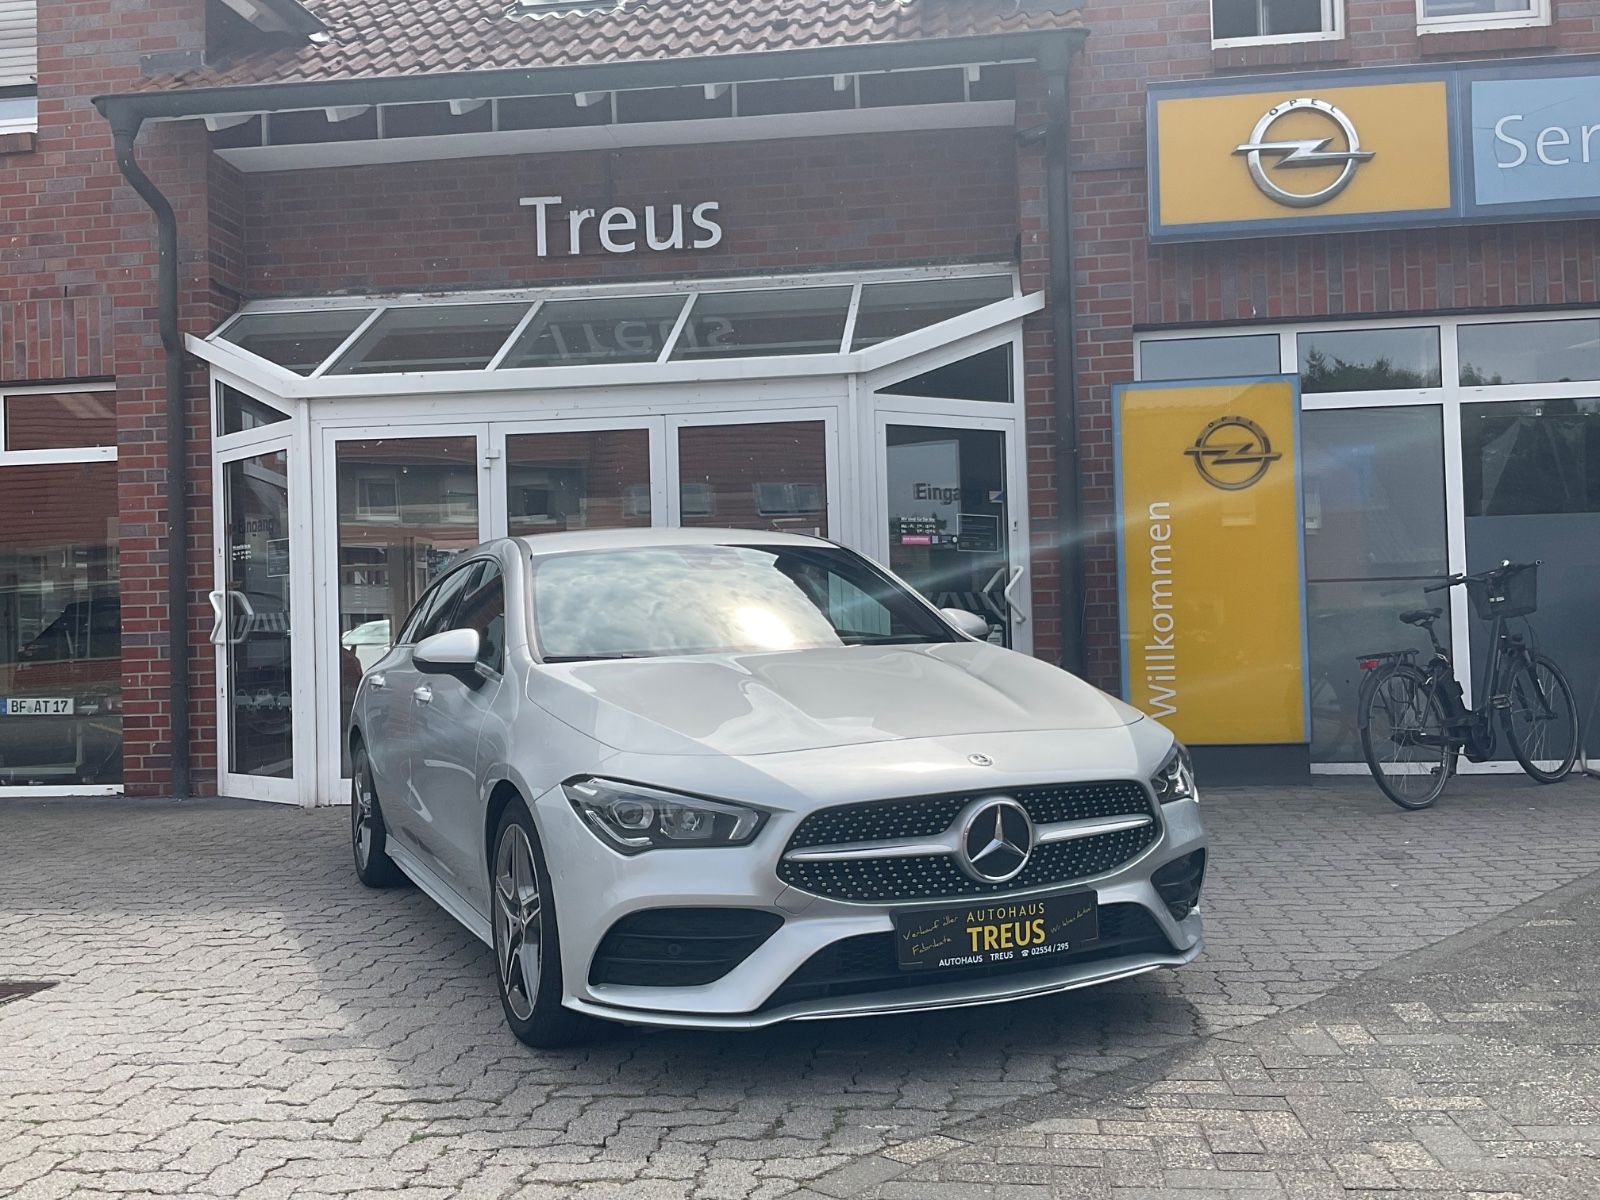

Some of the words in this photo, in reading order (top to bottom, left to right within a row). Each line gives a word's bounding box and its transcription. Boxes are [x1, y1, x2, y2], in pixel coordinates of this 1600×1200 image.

[1268, 98, 1335, 116] OPEL
[1494, 114, 1600, 169] Ser
[519, 196, 723, 257] Treus
[914, 482, 962, 505] Einga
[1144, 501, 1177, 720] Willkommen
[11, 700, 27, 713] BF
[34, 700, 50, 713] AT
[53, 700, 68, 713] 17
[966, 902, 1046, 922] AUTOHAUS
[966, 918, 1047, 952] TREUS
[938, 954, 983, 967] AUTOHAUS
[990, 951, 1014, 961] TREUS
